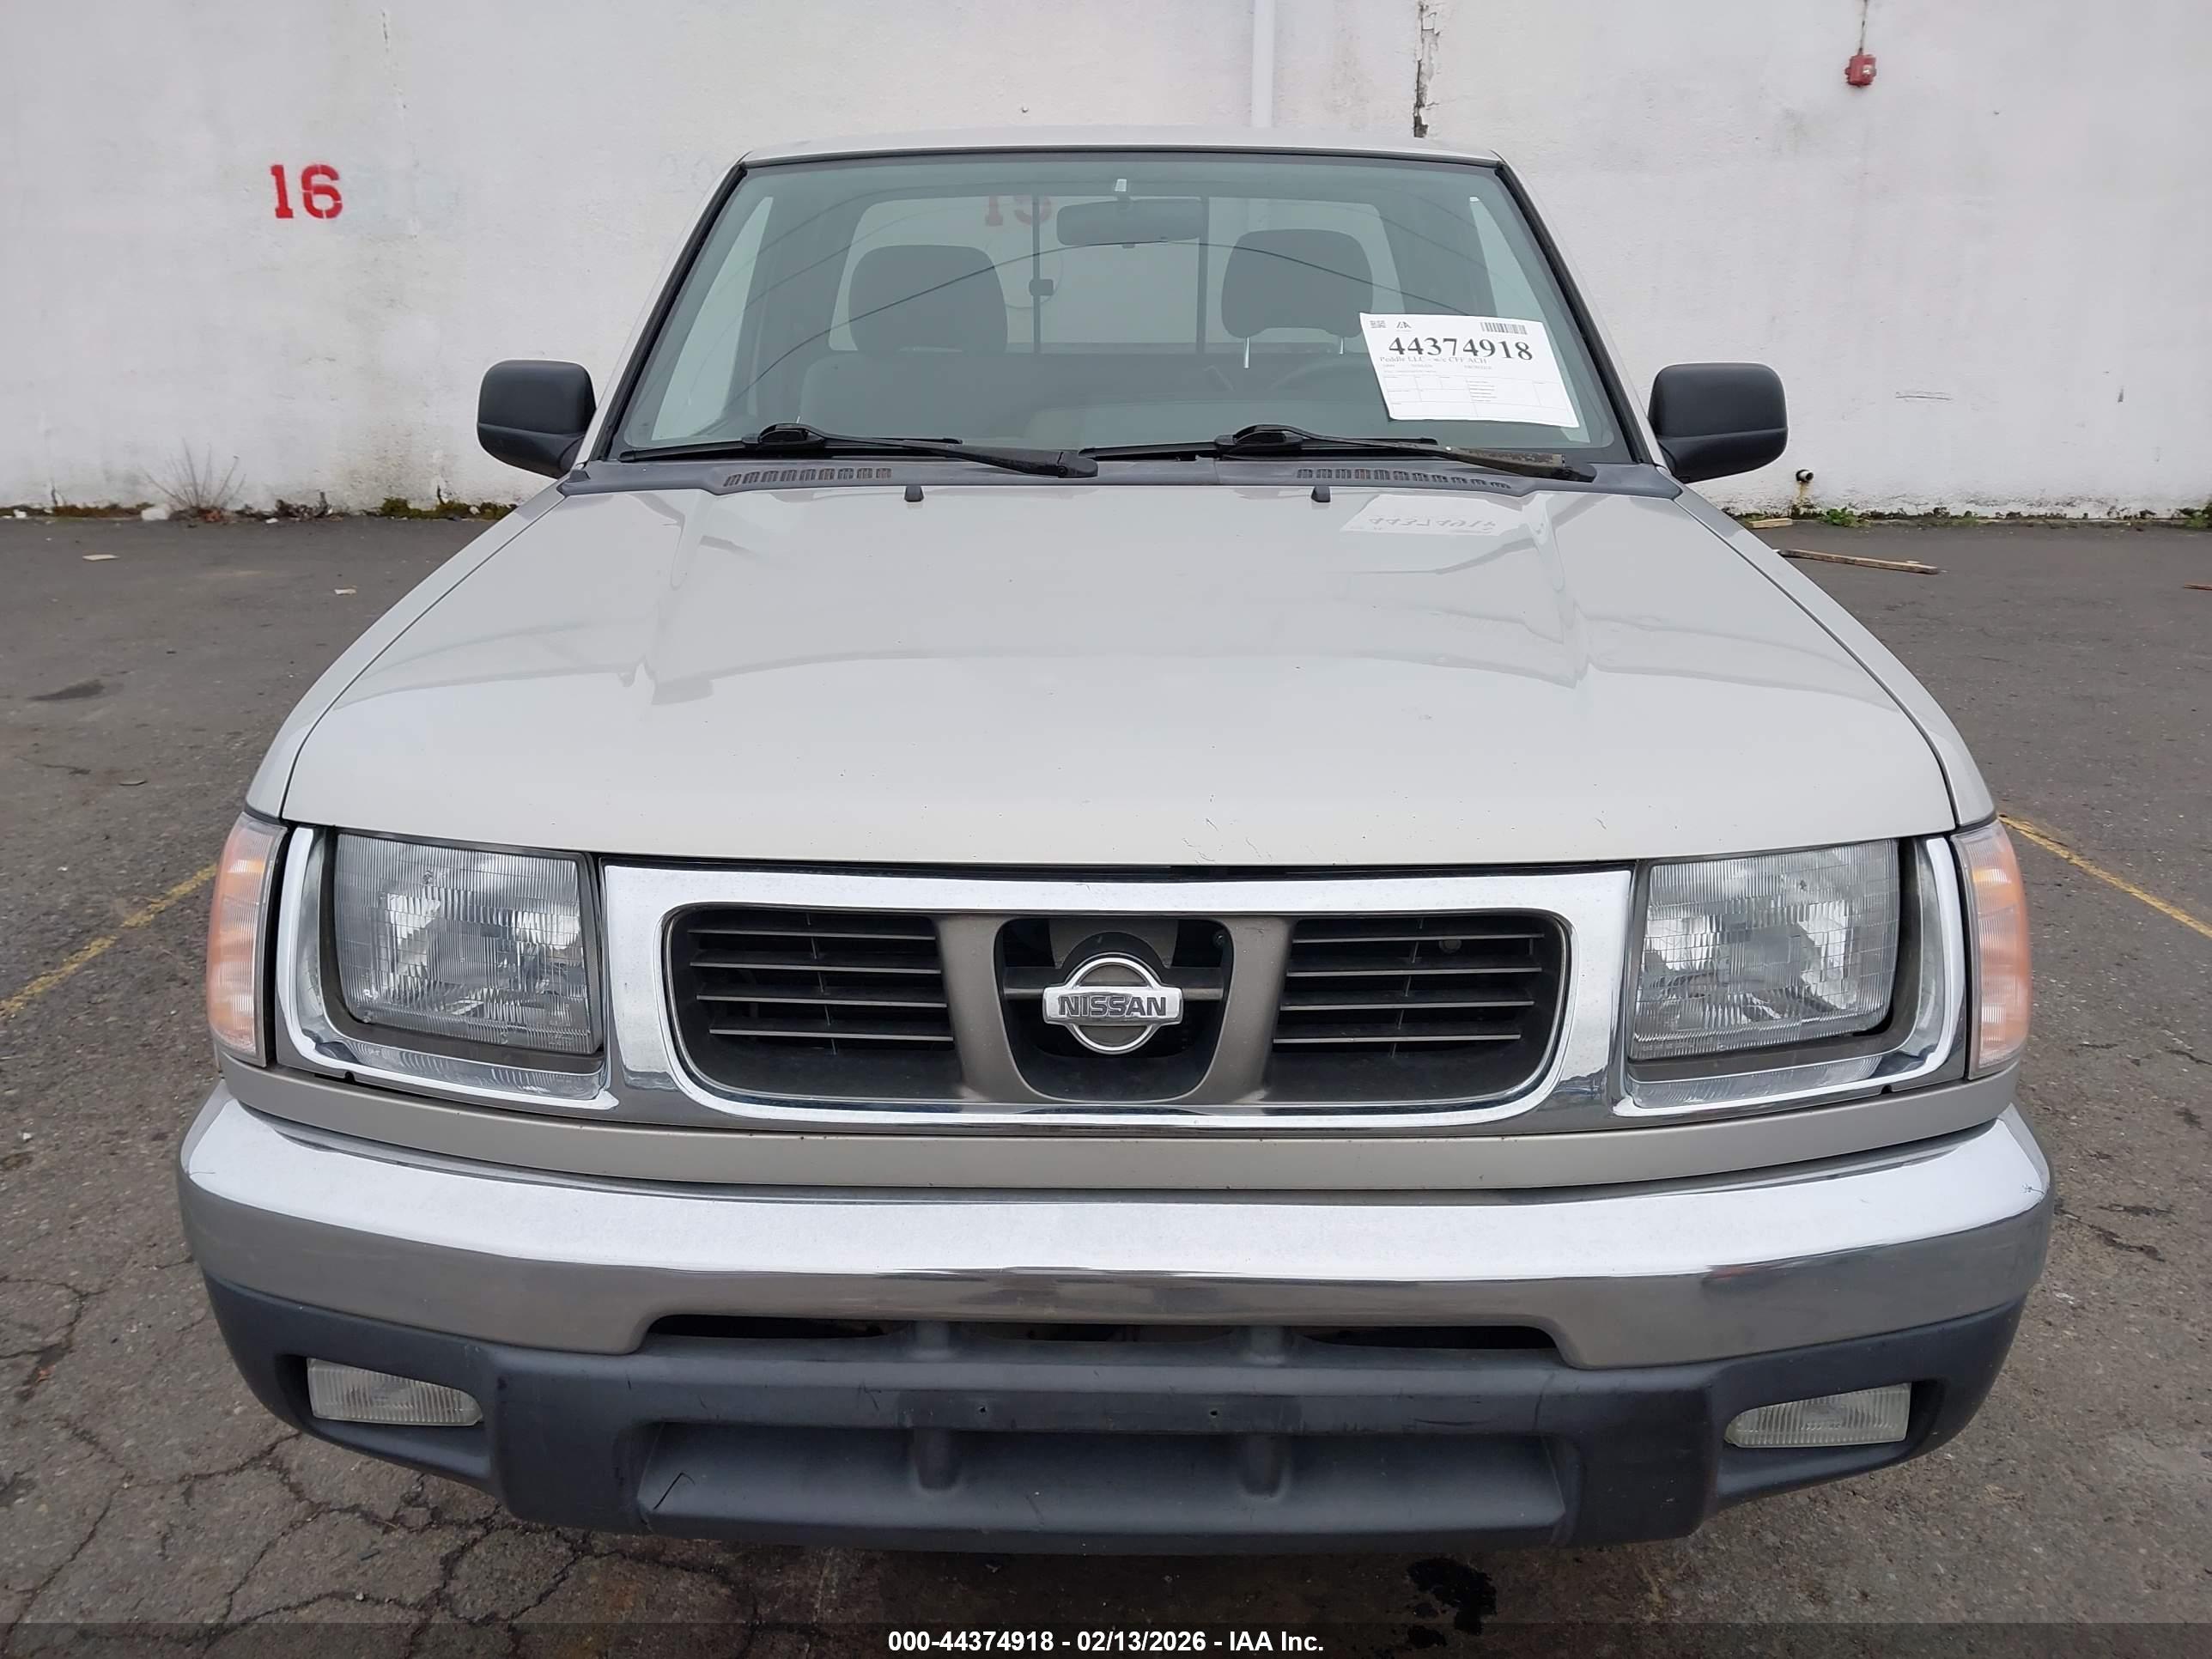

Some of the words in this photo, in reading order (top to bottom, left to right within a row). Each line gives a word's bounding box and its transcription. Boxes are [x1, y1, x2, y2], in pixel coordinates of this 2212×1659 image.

[270, 164, 343, 219] 16
[1389, 337, 1533, 361] 44374918
[1058, 995, 1166, 1017] NISSAN
